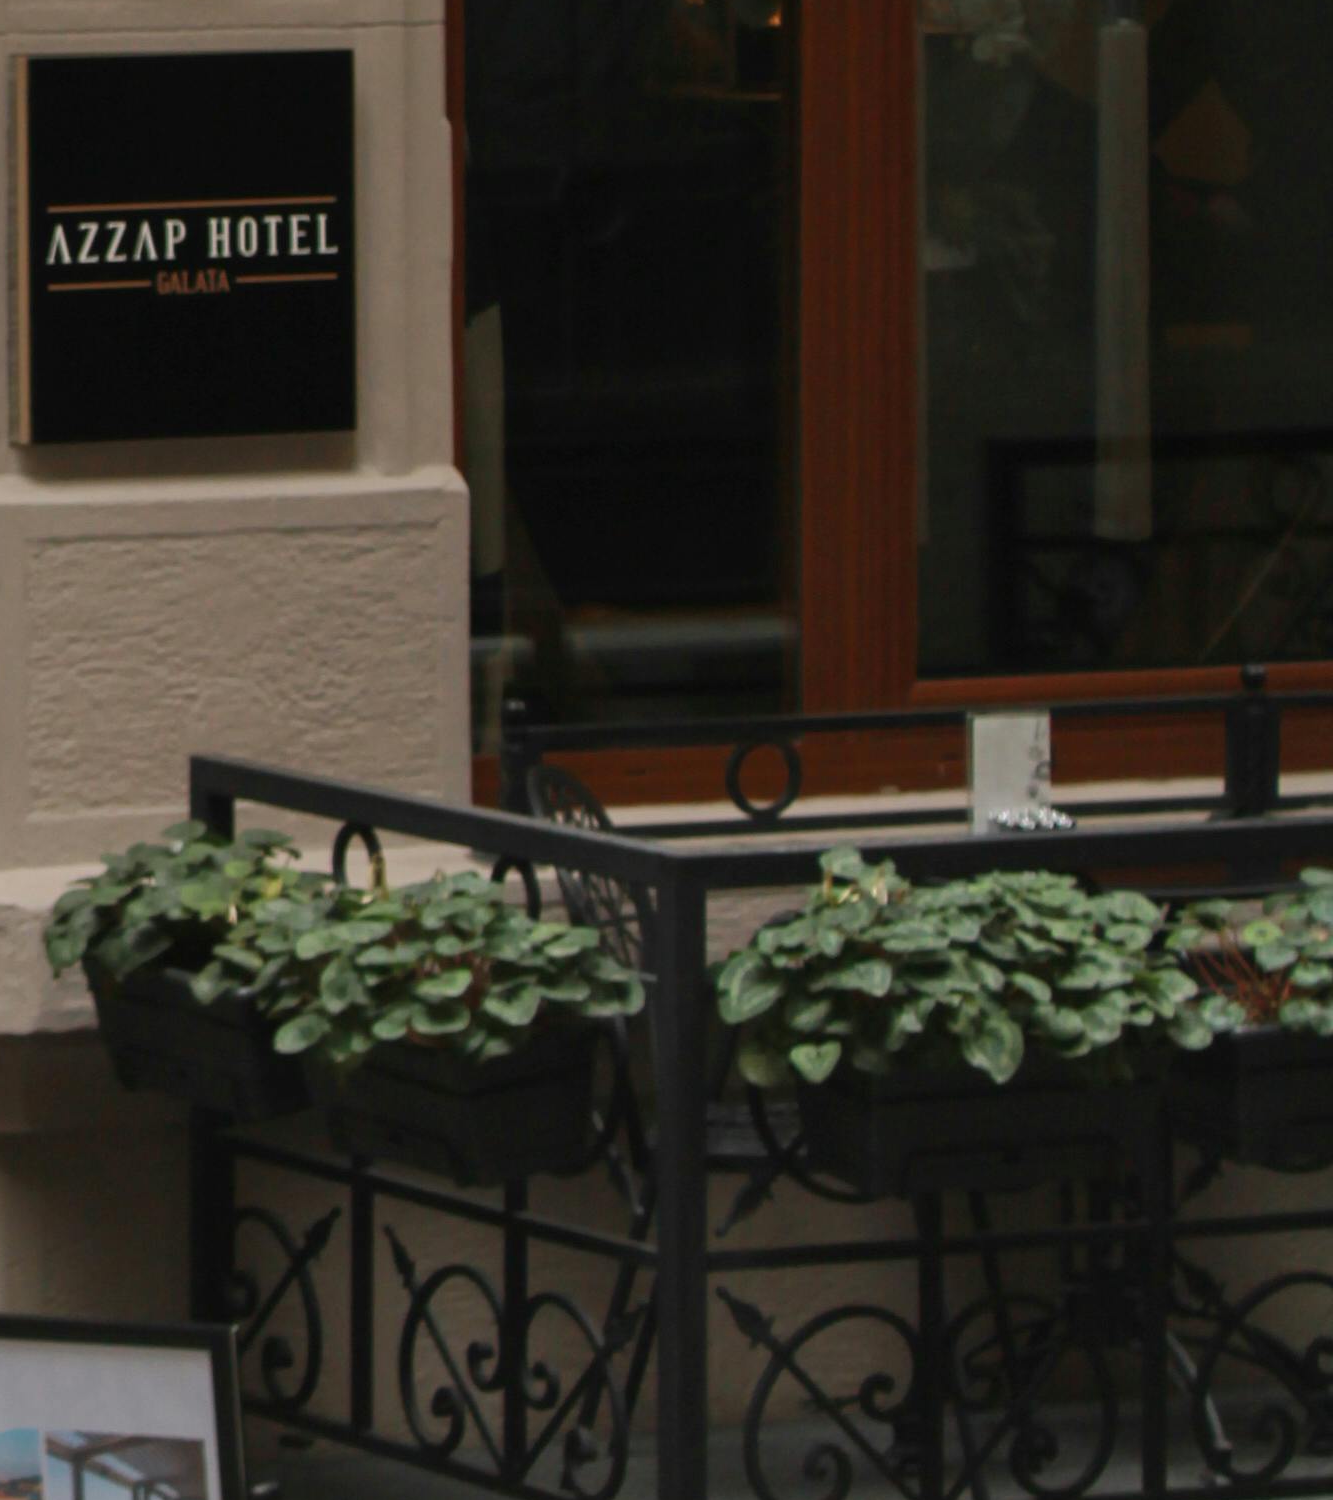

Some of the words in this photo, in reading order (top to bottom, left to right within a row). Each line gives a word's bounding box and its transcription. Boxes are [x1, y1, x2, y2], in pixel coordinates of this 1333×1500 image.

[46, 219, 187, 265] AZZAP
[207, 213, 339, 258] HOTEL
[156, 268, 231, 295] GALATA
